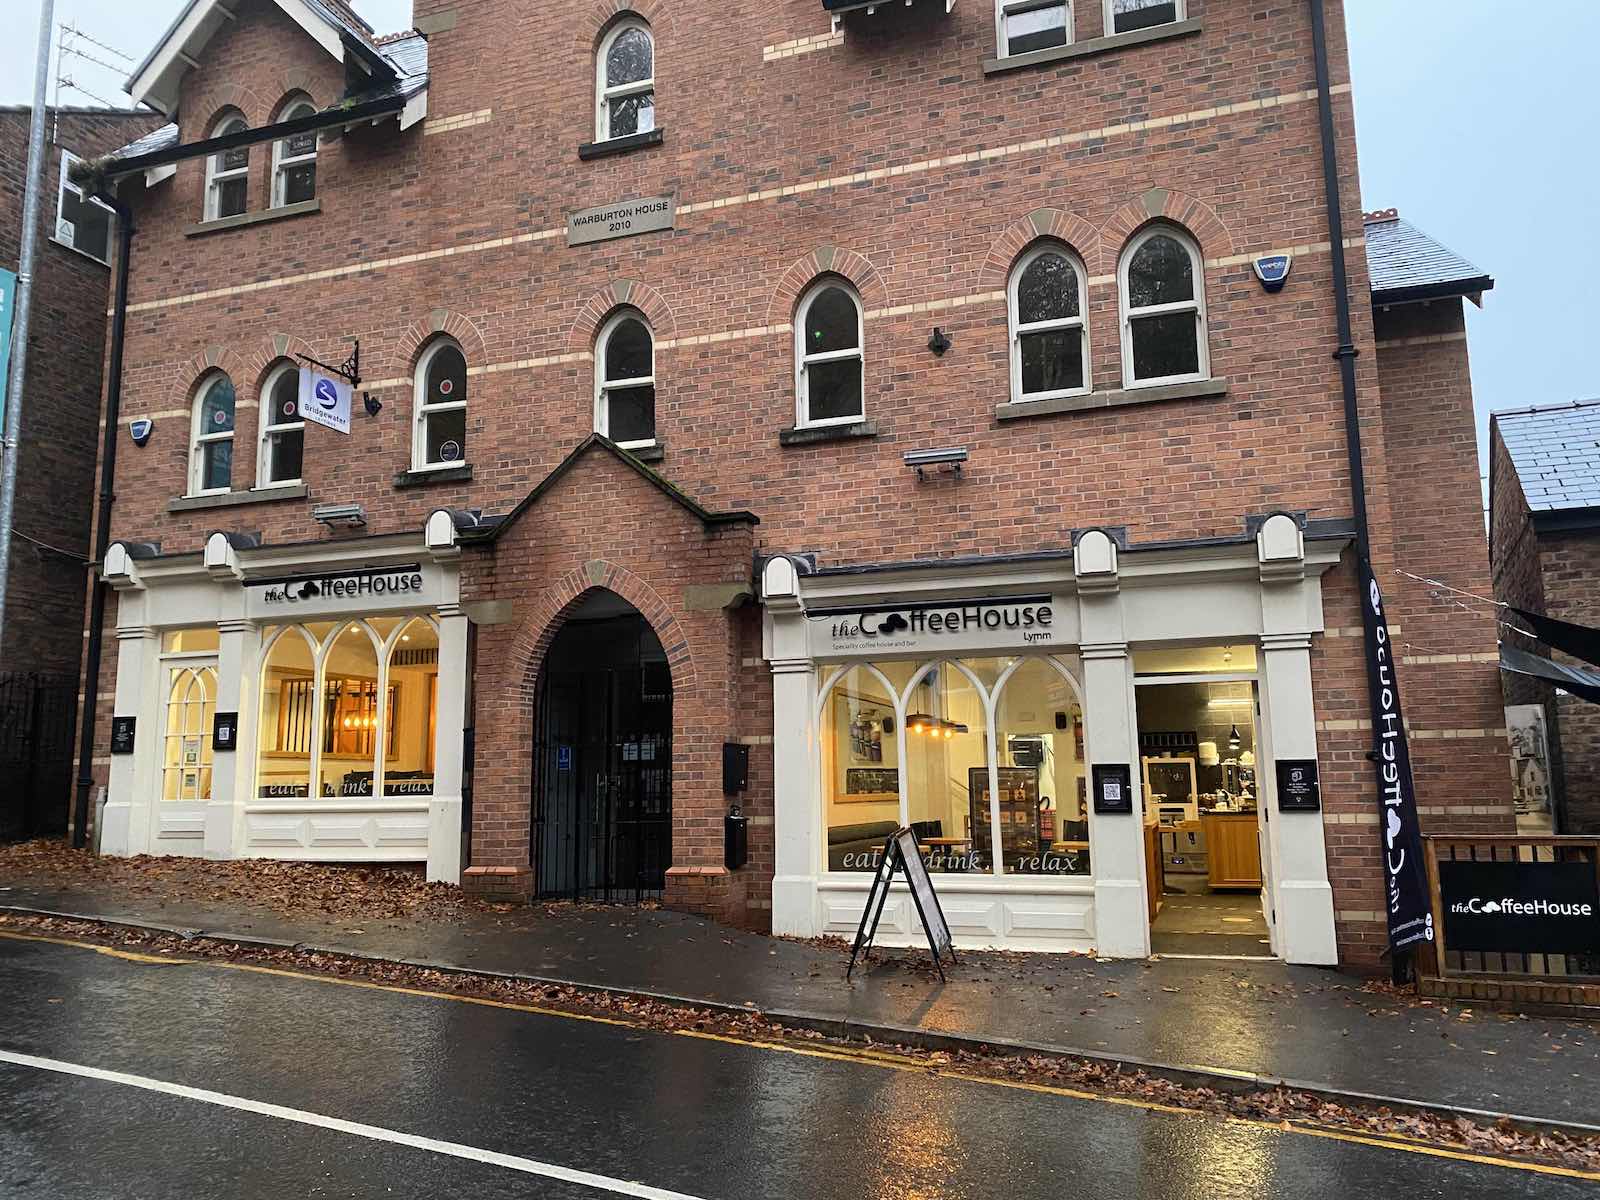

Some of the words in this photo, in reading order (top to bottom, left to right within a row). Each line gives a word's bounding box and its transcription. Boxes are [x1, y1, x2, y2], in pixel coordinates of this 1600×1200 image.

[573, 208, 633, 227] WARBURTON
[635, 201, 669, 215] HOUSE
[609, 220, 632, 232] 2010
[304, 403, 347, 425] Bridgewater
[1023, 631, 1052, 642] Lymm
[842, 850, 880, 869] eat
[923, 849, 982, 870] drink
[1017, 850, 1077, 871] relax
